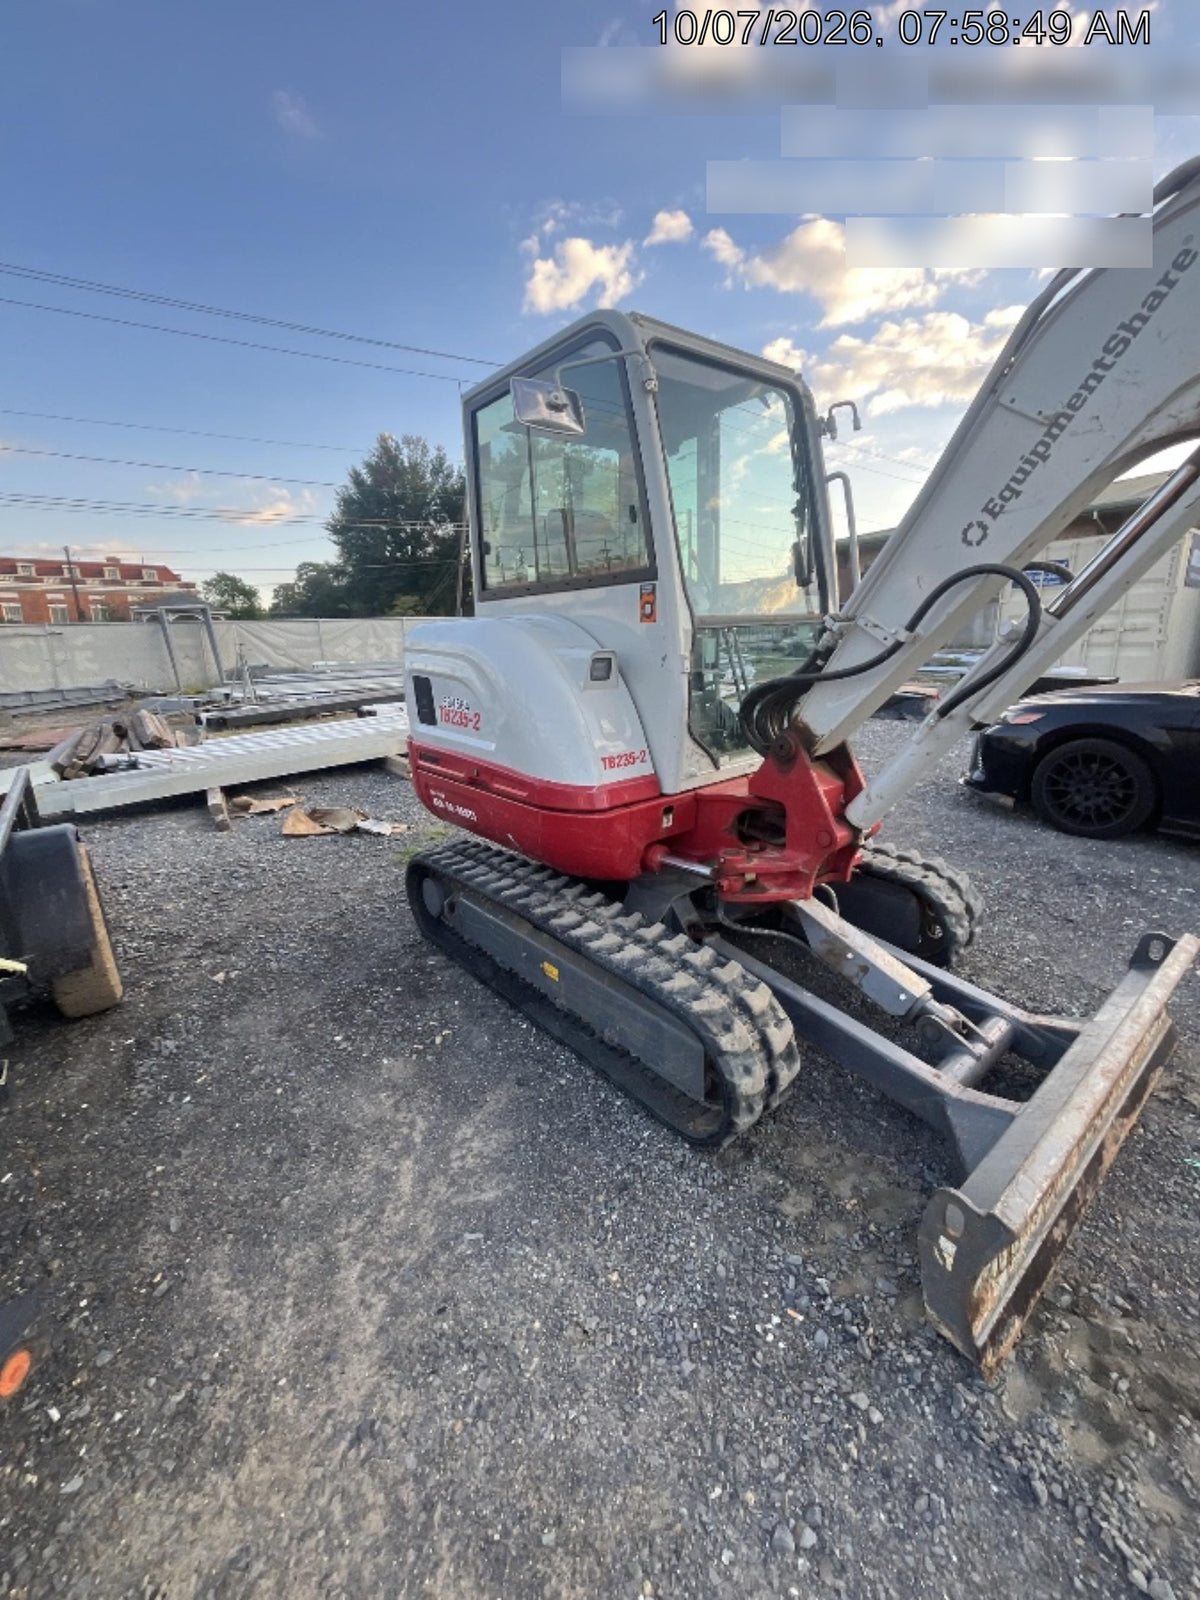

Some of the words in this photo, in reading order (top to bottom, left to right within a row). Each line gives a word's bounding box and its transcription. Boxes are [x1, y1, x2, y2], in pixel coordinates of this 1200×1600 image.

[981, 246, 1198, 521] EquipmentShare
[440, 706, 481, 731] TB235-2
[601, 750, 647, 770] TB235-2
